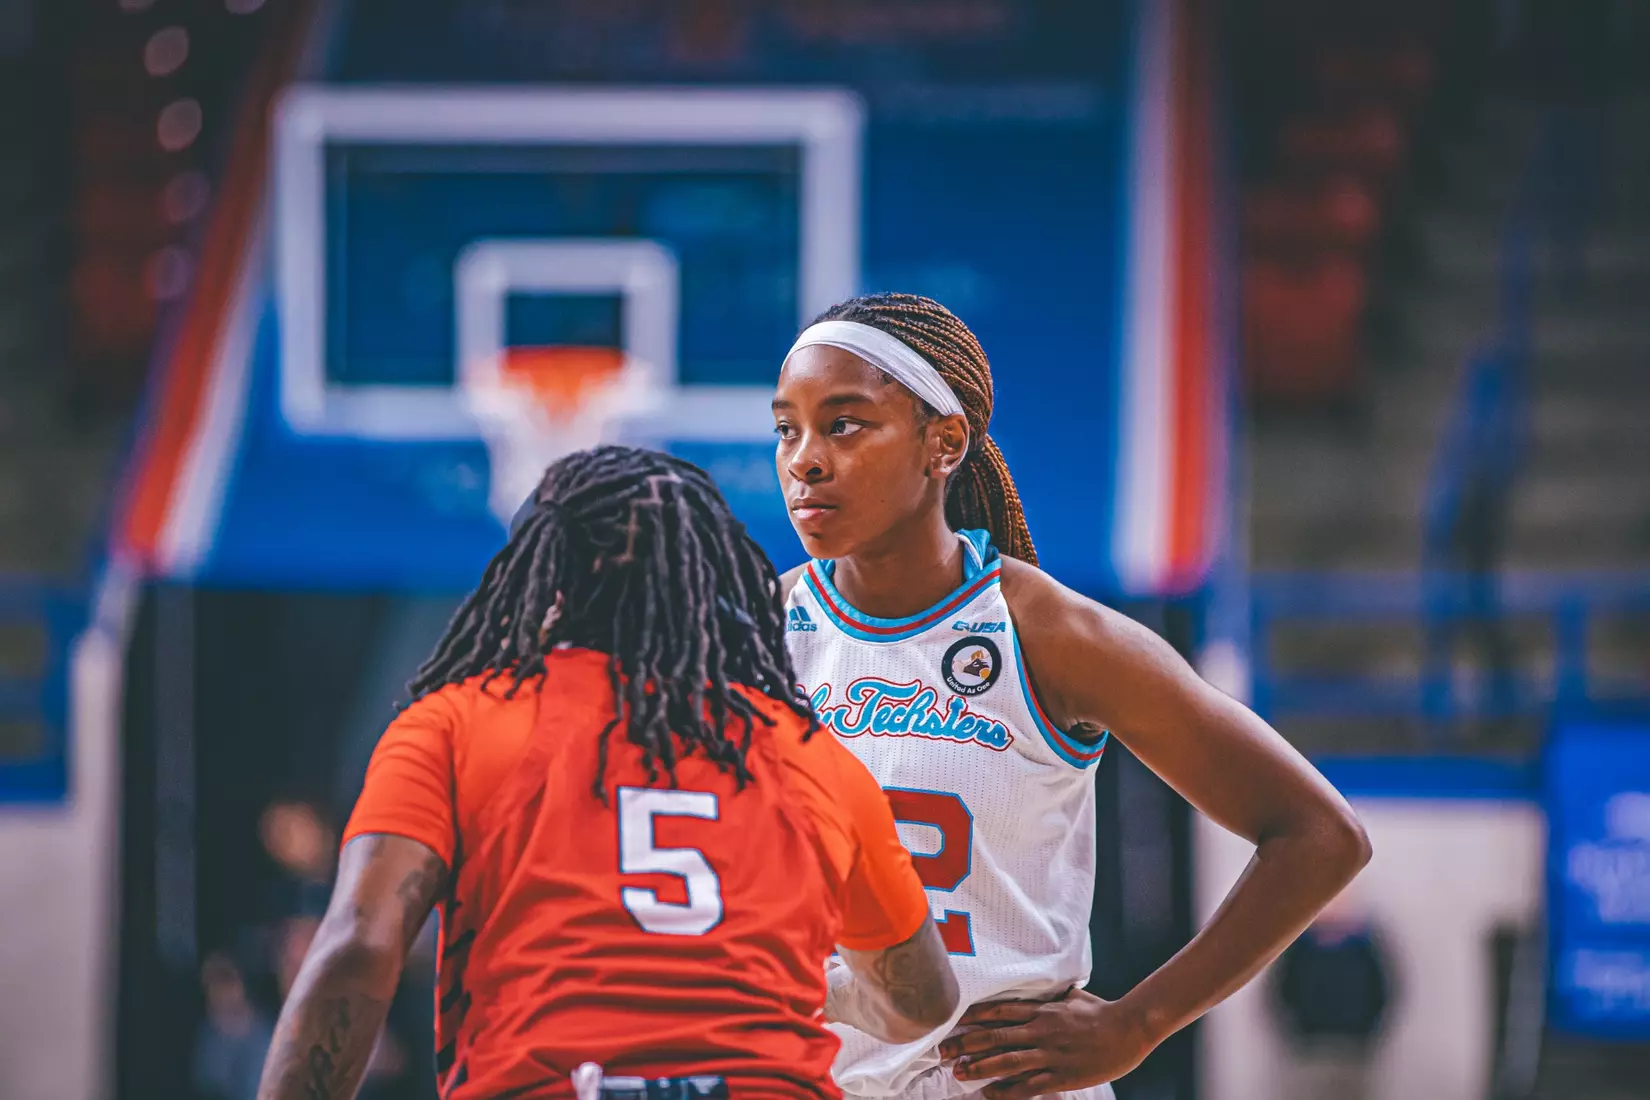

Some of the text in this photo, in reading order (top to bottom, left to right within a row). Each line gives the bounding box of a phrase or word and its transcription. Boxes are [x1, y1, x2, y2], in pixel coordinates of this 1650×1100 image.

[788, 620, 817, 632] idas
[946, 676, 991, 695] United As One
[832, 676, 1014, 752] Techsters
[617, 786, 723, 935] 5
